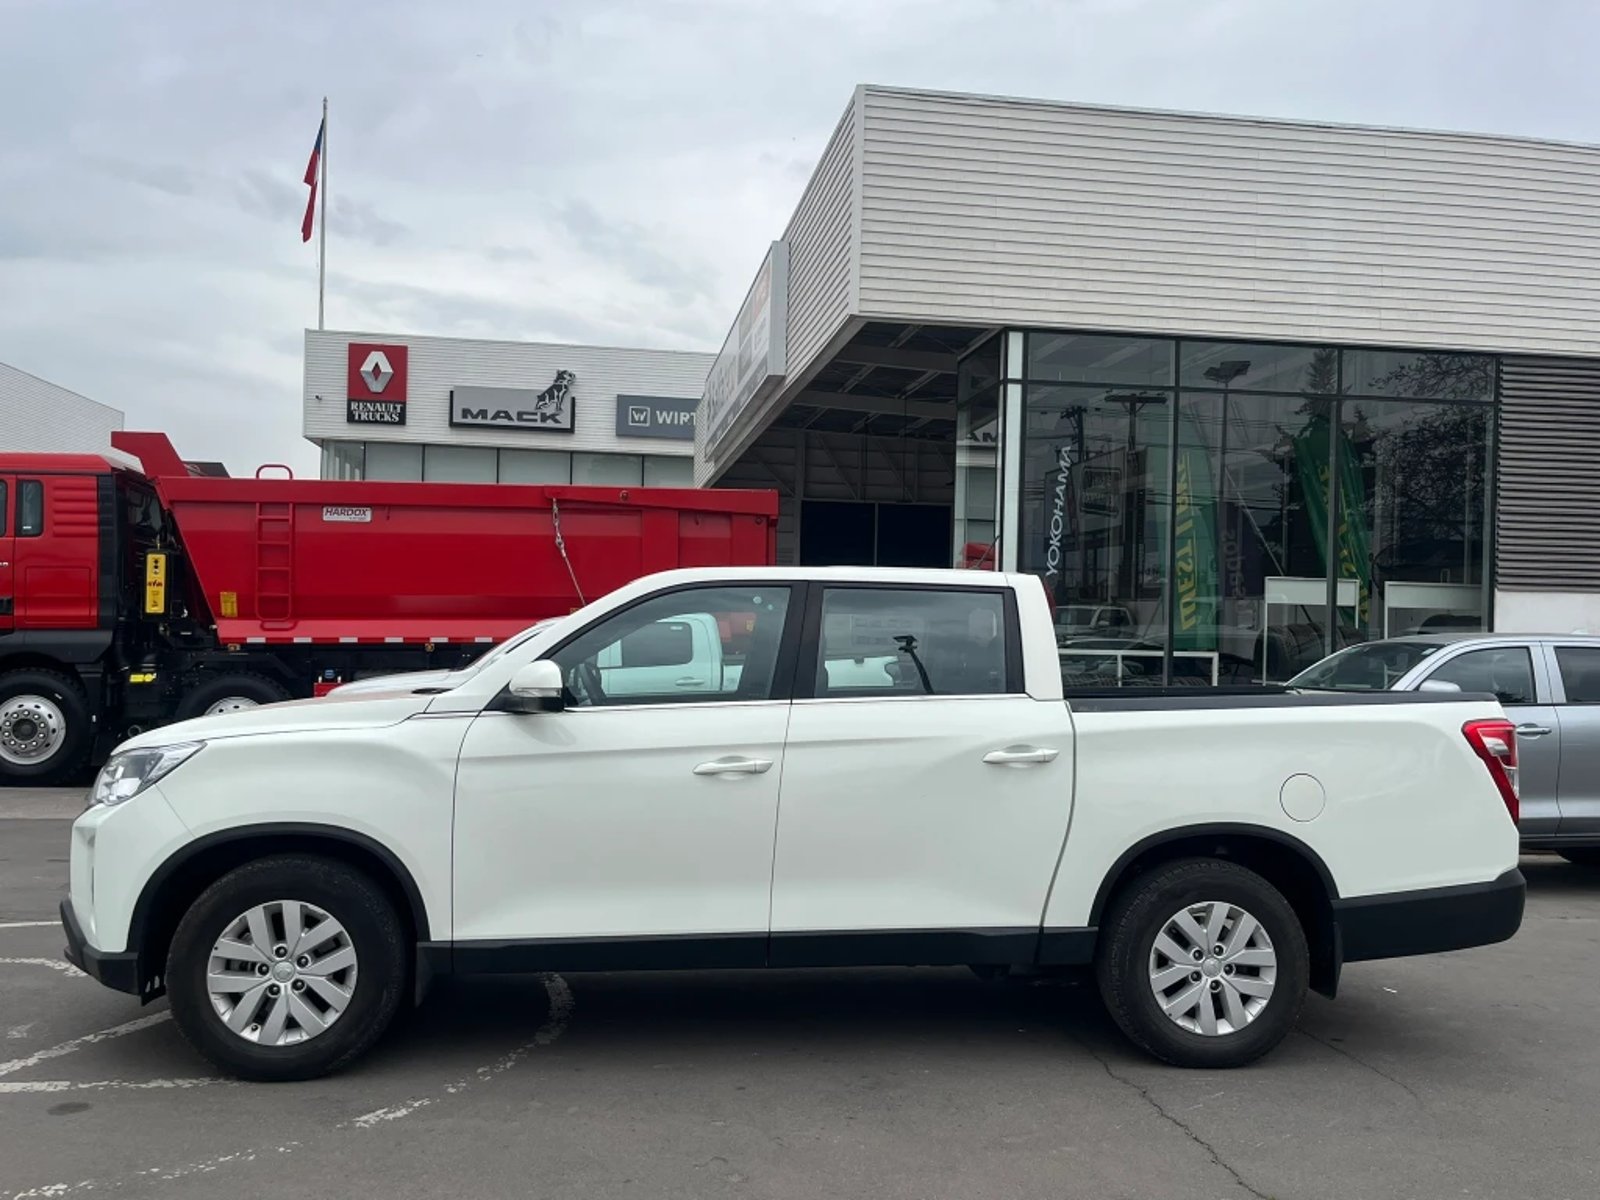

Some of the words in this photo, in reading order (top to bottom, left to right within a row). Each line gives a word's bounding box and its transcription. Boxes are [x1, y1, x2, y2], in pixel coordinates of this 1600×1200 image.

[350, 402, 403, 414] RENAULT
[352, 410, 400, 422] TRUCKS
[461, 407, 562, 424] MACK
[324, 508, 368, 517] HARDOX
[1045, 446, 1071, 576] YOKOHAMA
